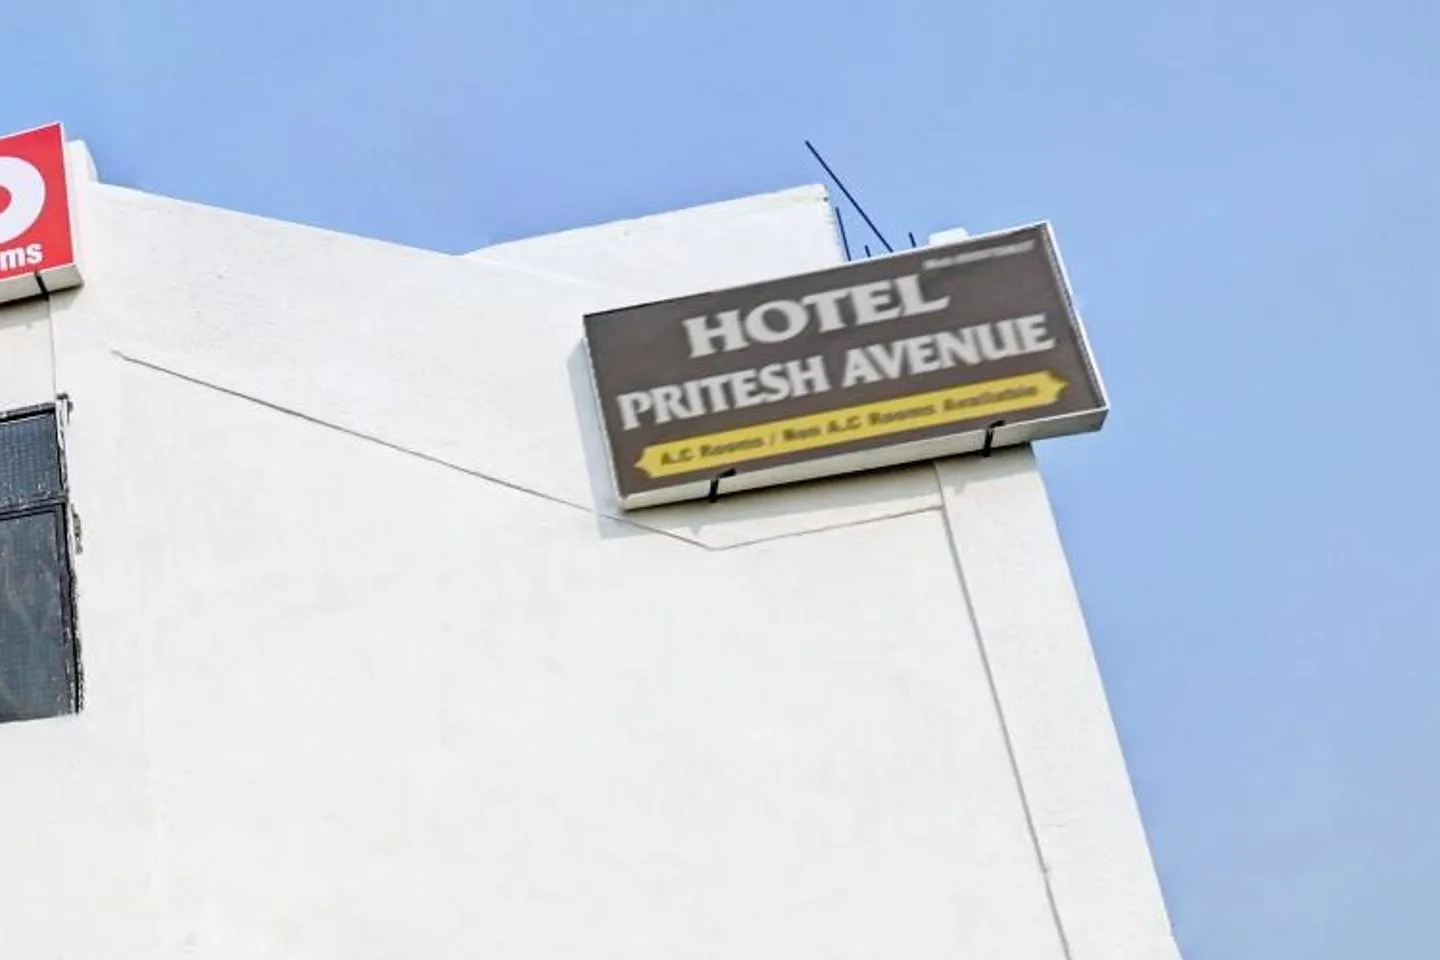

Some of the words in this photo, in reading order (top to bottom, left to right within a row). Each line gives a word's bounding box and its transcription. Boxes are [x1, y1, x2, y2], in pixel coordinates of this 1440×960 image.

[682, 274, 950, 358] HOTEL
[618, 355, 832, 431] PRITESH
[842, 313, 1056, 388] AVENUE
